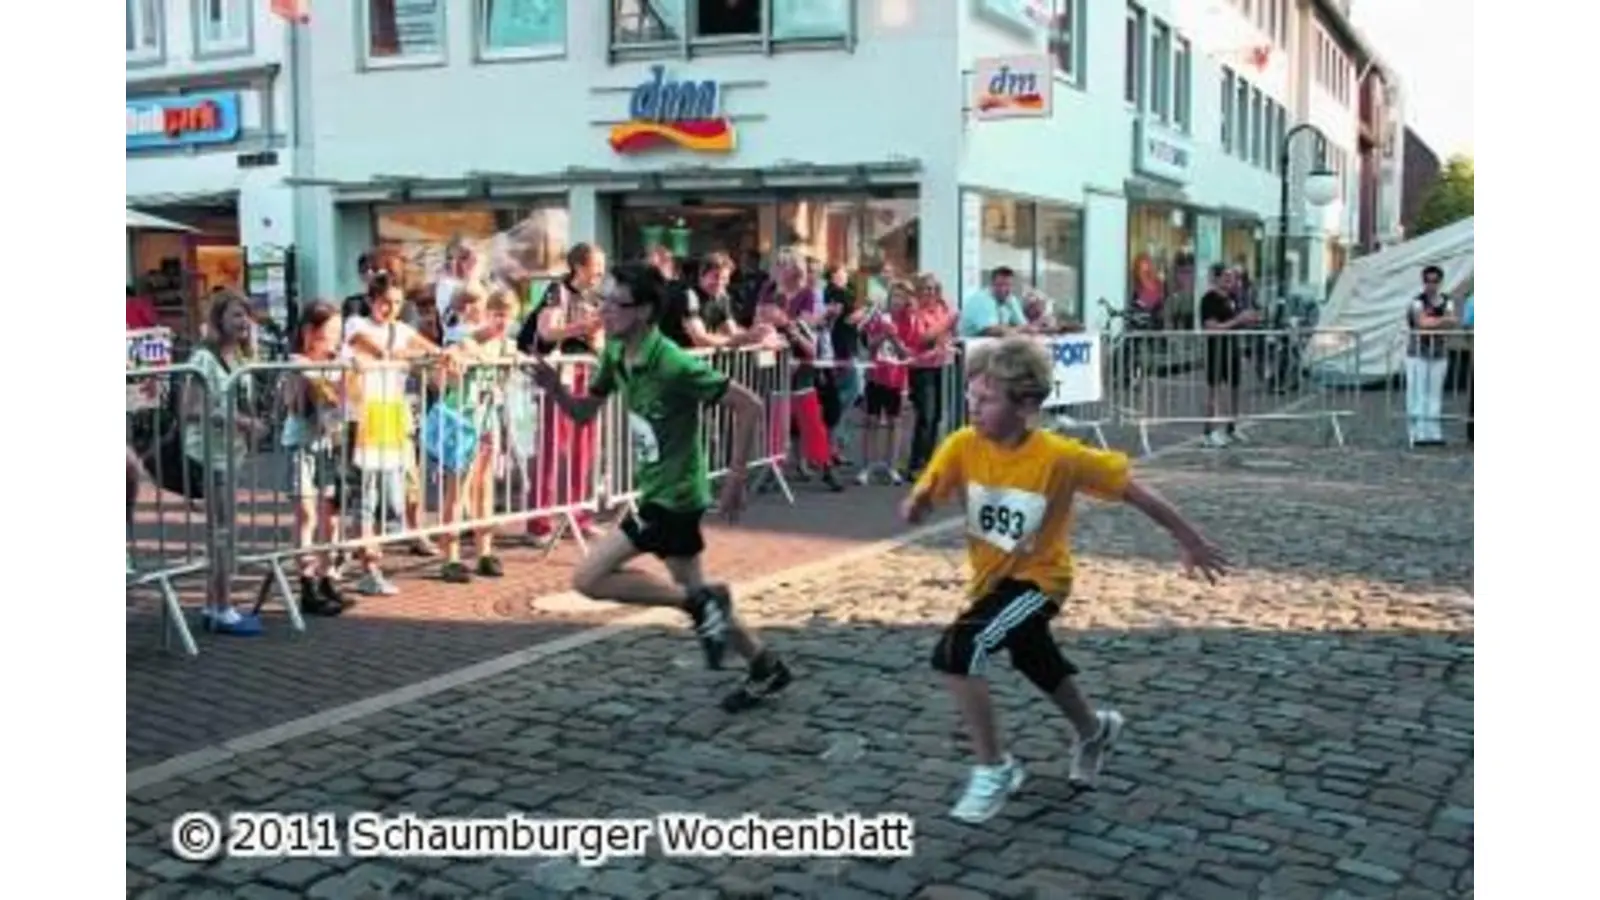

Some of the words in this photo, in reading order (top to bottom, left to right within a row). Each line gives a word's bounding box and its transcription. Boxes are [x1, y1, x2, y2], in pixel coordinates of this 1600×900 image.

[630, 65, 717, 123] dm
[989, 65, 1037, 95] dm
[1047, 342, 1093, 366] PORT
[979, 504, 1026, 540] 693
